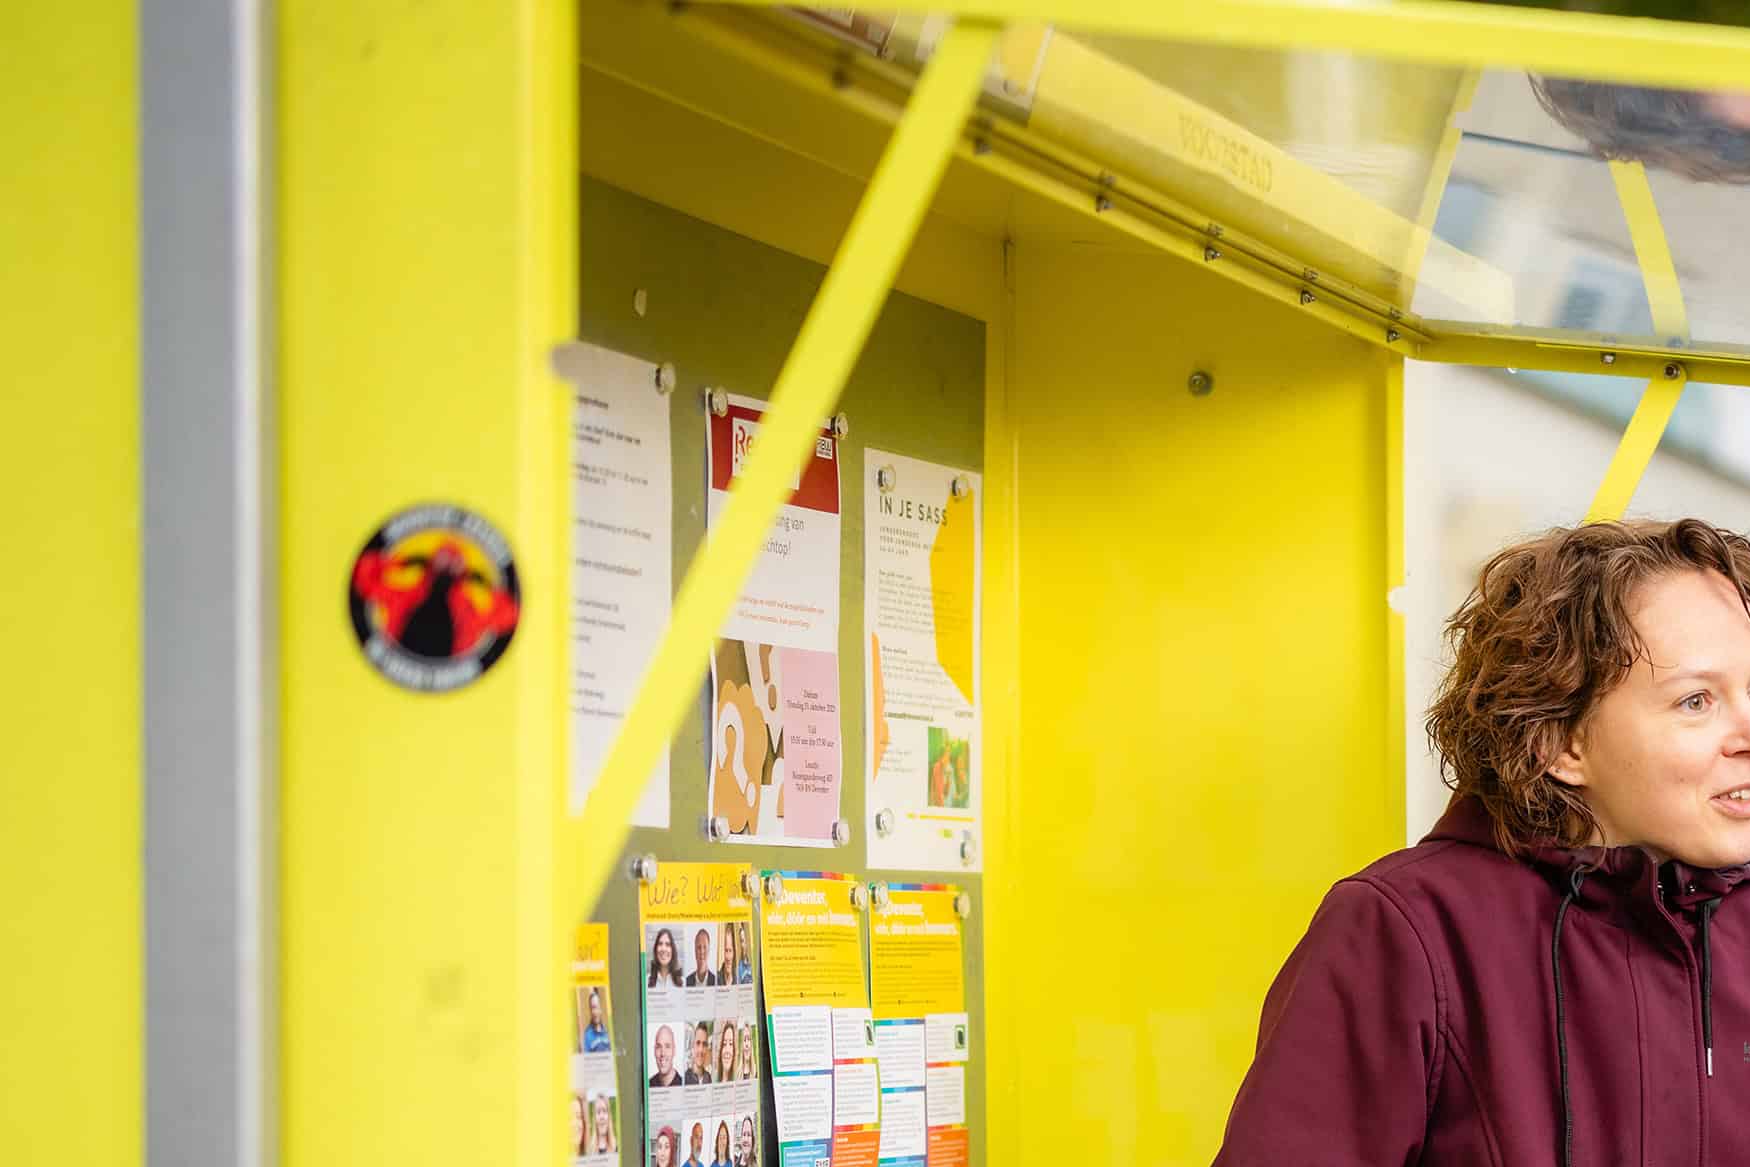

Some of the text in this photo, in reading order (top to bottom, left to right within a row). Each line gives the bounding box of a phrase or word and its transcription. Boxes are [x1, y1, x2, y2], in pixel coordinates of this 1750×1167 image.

[880, 495, 948, 527] IN JE SASS
